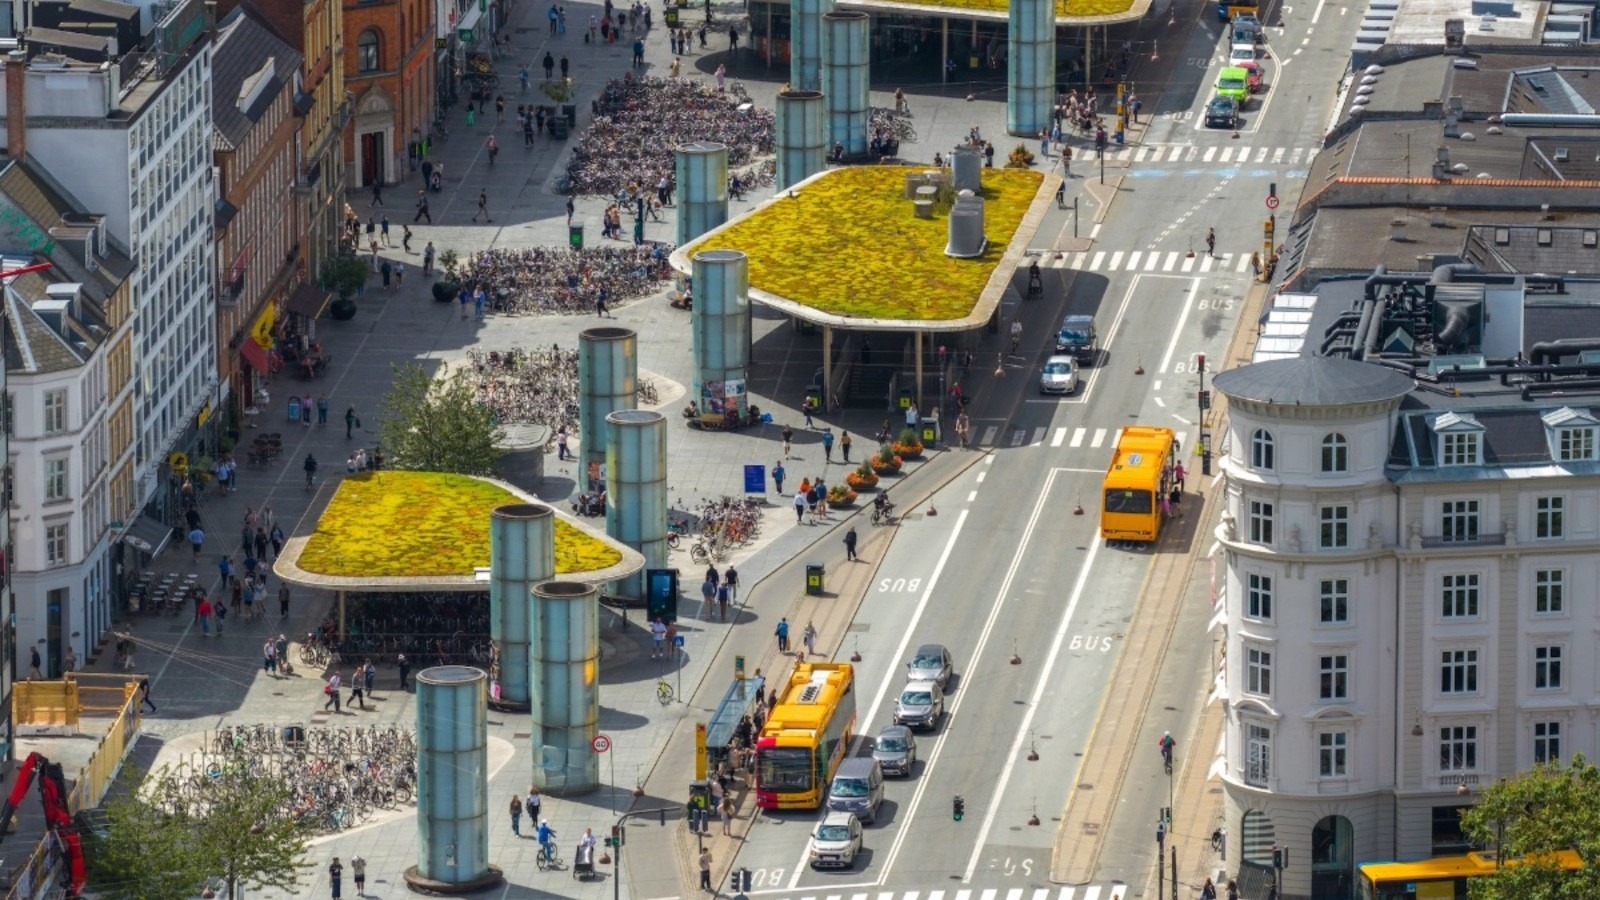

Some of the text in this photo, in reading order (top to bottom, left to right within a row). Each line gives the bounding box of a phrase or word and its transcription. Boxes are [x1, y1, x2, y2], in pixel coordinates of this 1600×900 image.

[1162, 110, 1194, 120] BUS
[1198, 299, 1234, 310] BUS
[1174, 361, 1212, 374] BUS
[878, 577, 922, 593] BUS
[1069, 635, 1113, 652] BUS
